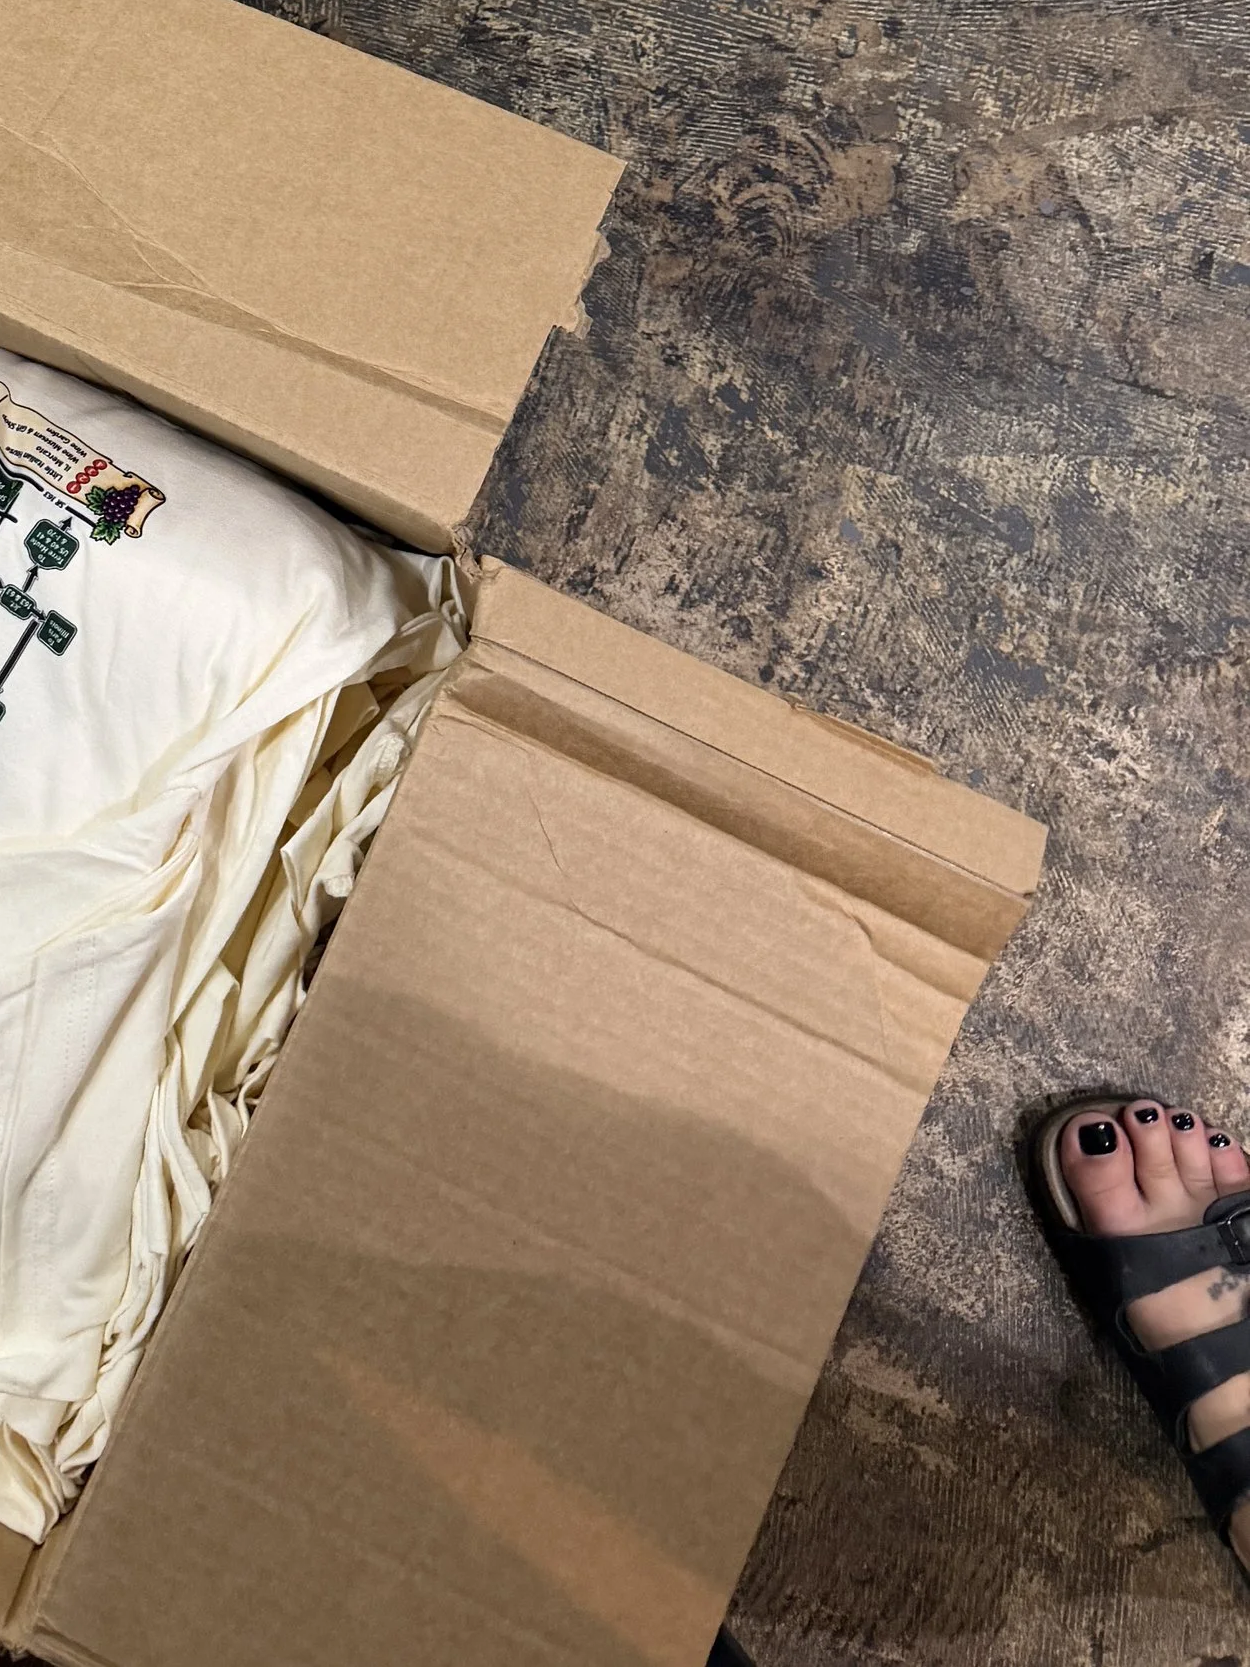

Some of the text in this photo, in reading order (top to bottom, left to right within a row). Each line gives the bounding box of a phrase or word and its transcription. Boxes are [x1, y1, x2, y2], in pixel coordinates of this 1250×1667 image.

[33, 430, 62, 452] Museum
[46, 427, 88, 458] Wine Garden
[35, 445, 65, 469] Mercato
[61, 449, 79, 464] Wine
[44, 465, 63, 482] Little
[43, 491, 66, 509] SR 163
[36, 531, 69, 556] US 40 & 41
[60, 537, 68, 545] &
[30, 537, 65, 565] Terre Haute
[37, 554, 47, 563] To
[20, 597, 33, 610] 163
[47, 637, 55, 647] To
